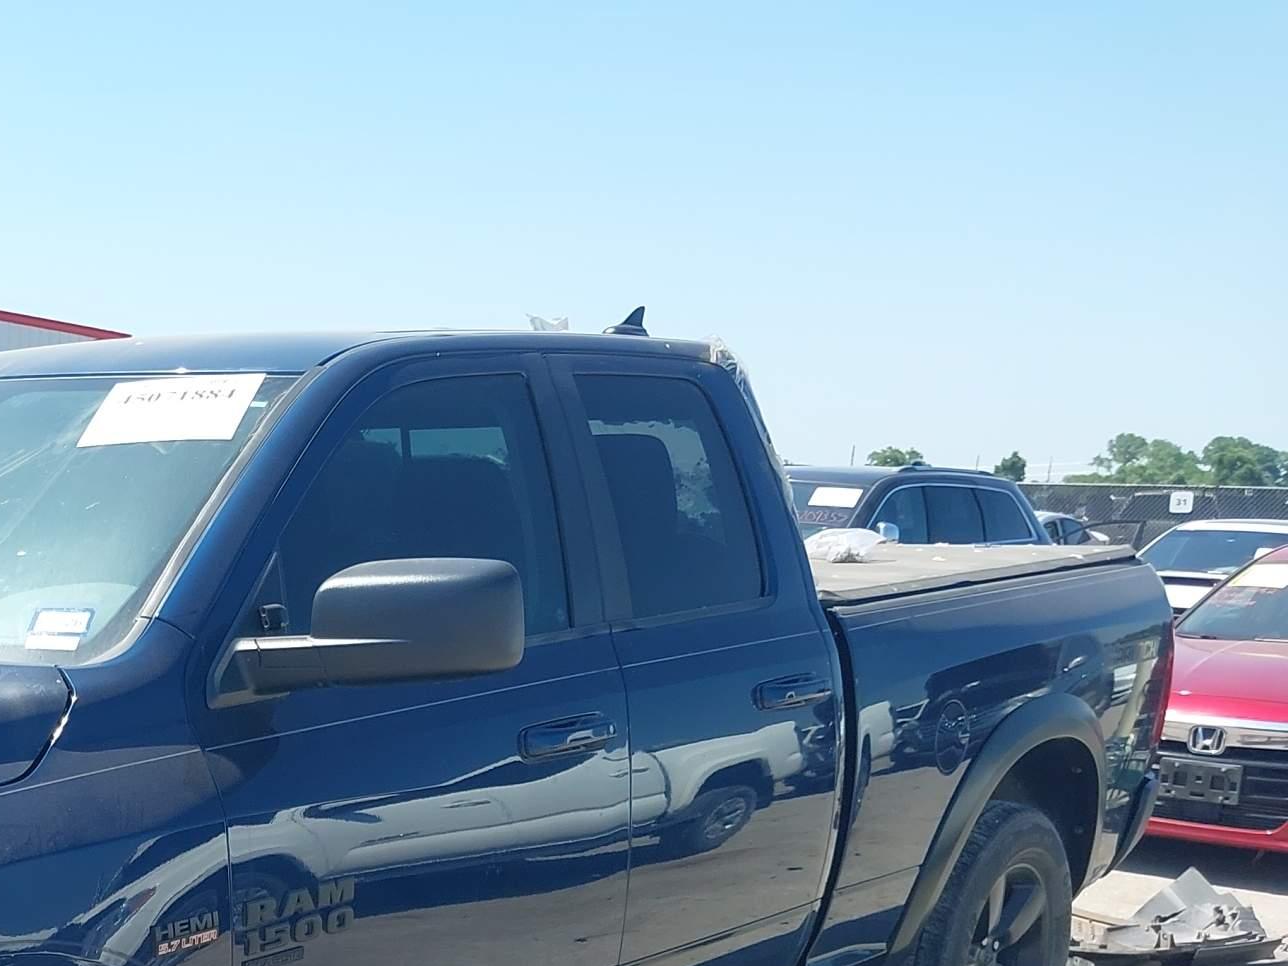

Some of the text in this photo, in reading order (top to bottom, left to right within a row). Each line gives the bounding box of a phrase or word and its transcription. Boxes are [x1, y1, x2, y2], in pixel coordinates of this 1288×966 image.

[1175, 497, 1188, 507] 31
[242, 878, 355, 925] RAM
[155, 911, 220, 941] HEMI
[181, 929, 217, 949] LITER
[243, 906, 355, 957] 1500
